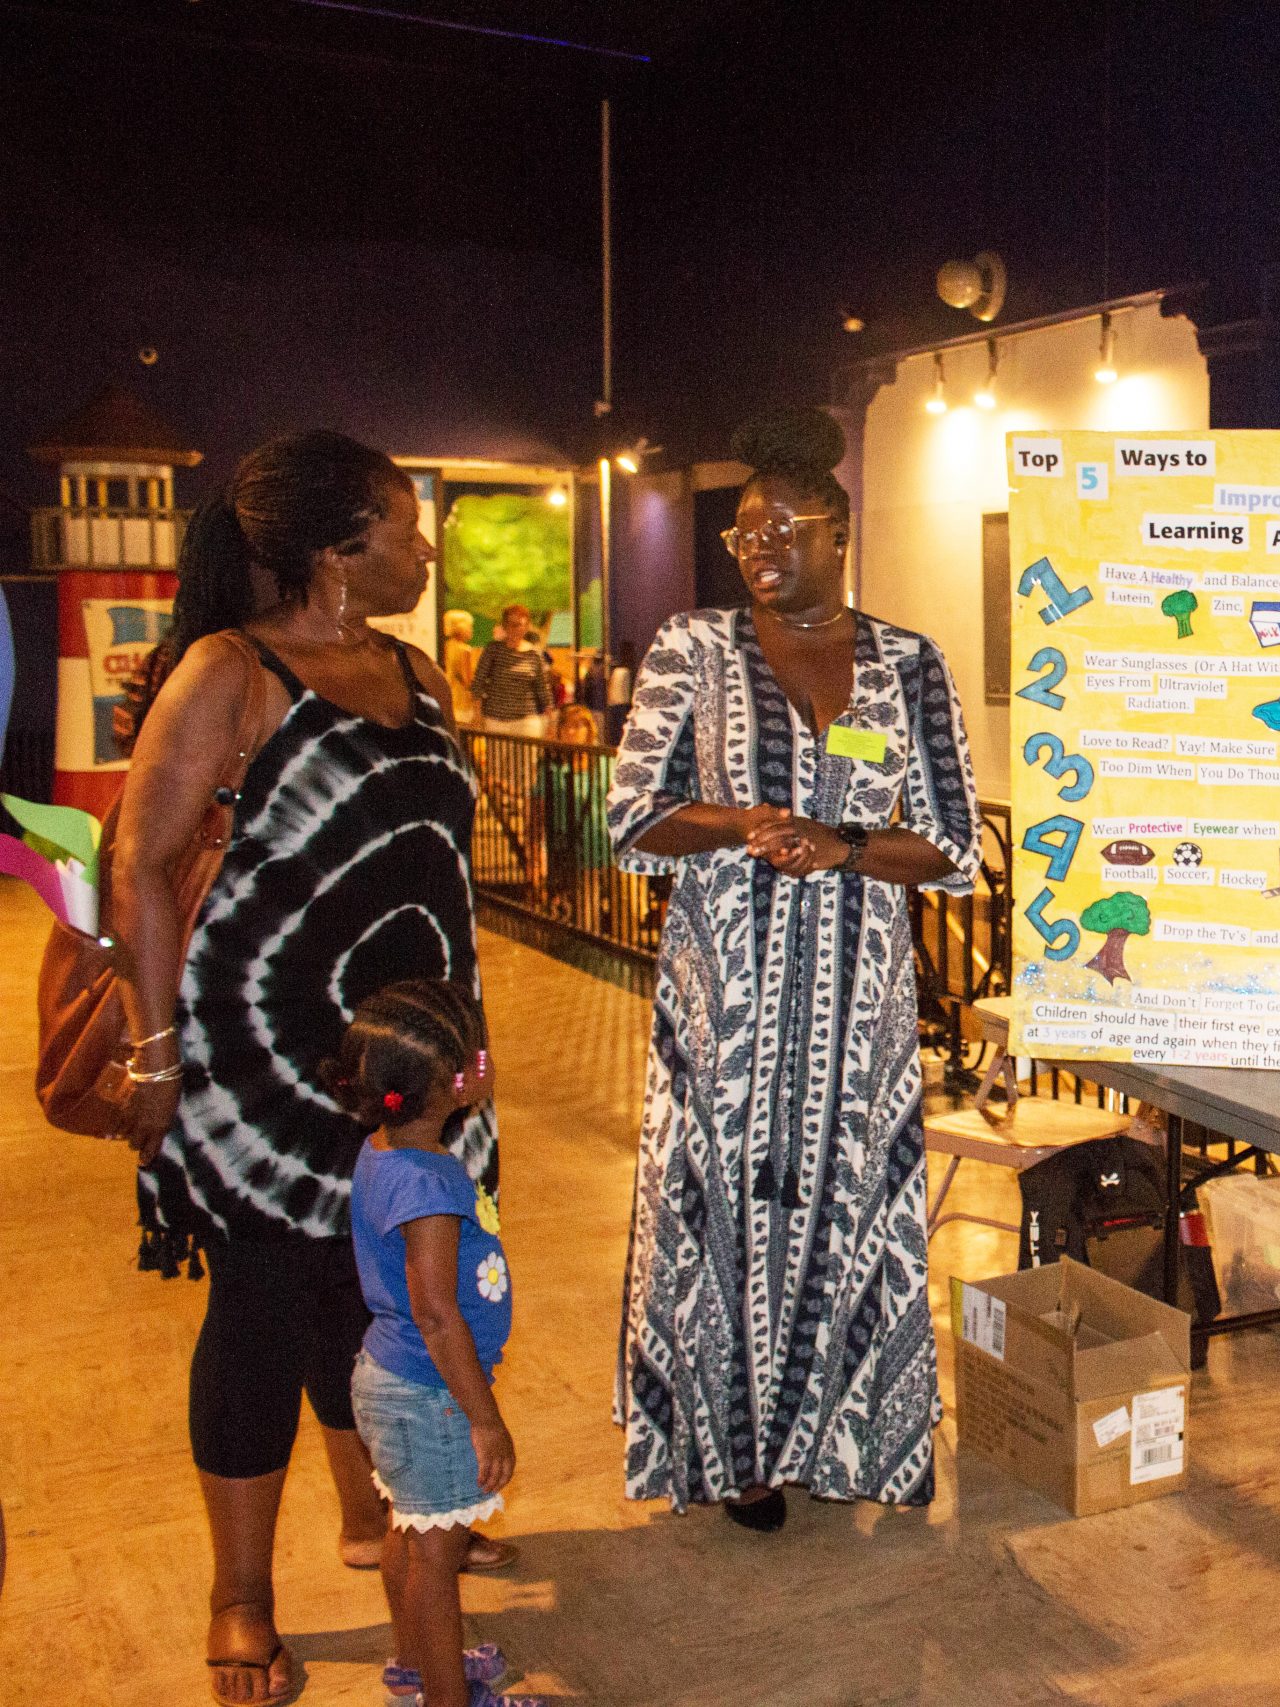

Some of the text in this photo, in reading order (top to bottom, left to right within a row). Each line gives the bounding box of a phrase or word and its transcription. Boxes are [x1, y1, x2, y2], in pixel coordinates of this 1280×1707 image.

[1019, 451, 1058, 472] Top
[1082, 467, 1098, 489] 5
[1121, 450, 1180, 471] Ways
[1186, 450, 1207, 466] to
[1149, 522, 1243, 544] Learning
[1105, 568, 1136, 580] Have
[1151, 573, 1193, 588] Healthy
[1204, 576, 1227, 586] and
[1017, 557, 1093, 625] 1
[1111, 592, 1154, 605] Lutein,
[1214, 600, 1242, 612] Zinc,
[1085, 656, 1117, 667] Wear
[1122, 657, 1187, 671] Sunglasses
[1194, 660, 1213, 673] (Or
[1219, 662, 1227, 672] A
[1232, 662, 1253, 672] Hat
[1015, 647, 1067, 711] 2
[1087, 676, 1223, 693] Eyes From Ultraviolet
[1128, 697, 1189, 710] Radiation.
[1083, 736, 1112, 746] Love
[1116, 737, 1127, 747] to
[1132, 738, 1168, 749] Read?
[1179, 740, 1206, 754] Yay!
[1210, 742, 1242, 753] Make
[1247, 743, 1275, 755] Sure
[1023, 732, 1094, 802] 3
[1101, 761, 1123, 772] Too
[1128, 762, 1152, 774] Dim
[1156, 764, 1192, 776] When
[1200, 767, 1223, 779] You
[1227, 768, 1244, 779] Do
[1093, 824, 1124, 835] Wear
[1129, 822, 1182, 833] Protective
[1194, 823, 1238, 835] Eyewear
[1243, 825, 1276, 835] when
[1021, 814, 1084, 882] 4
[1105, 868, 1157, 880] Football,
[1168, 869, 1209, 880] Soccer,
[1221, 873, 1266, 887] Hockey
[1024, 887, 1080, 962] 5
[1163, 924, 1194, 938] Drop
[1198, 927, 1216, 939] the
[1220, 929, 1246, 941] Tv's
[1256, 933, 1279, 944] and
[1135, 994, 1158, 1005] And
[1163, 994, 1195, 1007] Don't
[1204, 998, 1243, 1011] Forget
[1036, 1006, 1087, 1019] Children
[1094, 1012, 1135, 1025] should
[1140, 1015, 1168, 1027] have
[1179, 1018, 1207, 1030] their
[1212, 1020, 1234, 1031] first
[1239, 1023, 1260, 1034] eye
[1027, 1027, 1038, 1037] at
[1055, 1028, 1087, 1040] years
[1091, 1030, 1103, 1039] of
[1109, 1034, 1131, 1048] age
[1135, 1034, 1158, 1044] and
[1163, 1035, 1196, 1050] again
[1202, 1039, 1237, 1049] when
[1242, 1039, 1268, 1052] they
[1134, 1050, 1166, 1062] every
[1195, 1051, 1228, 1065] years
[1231, 1055, 1258, 1067] until
